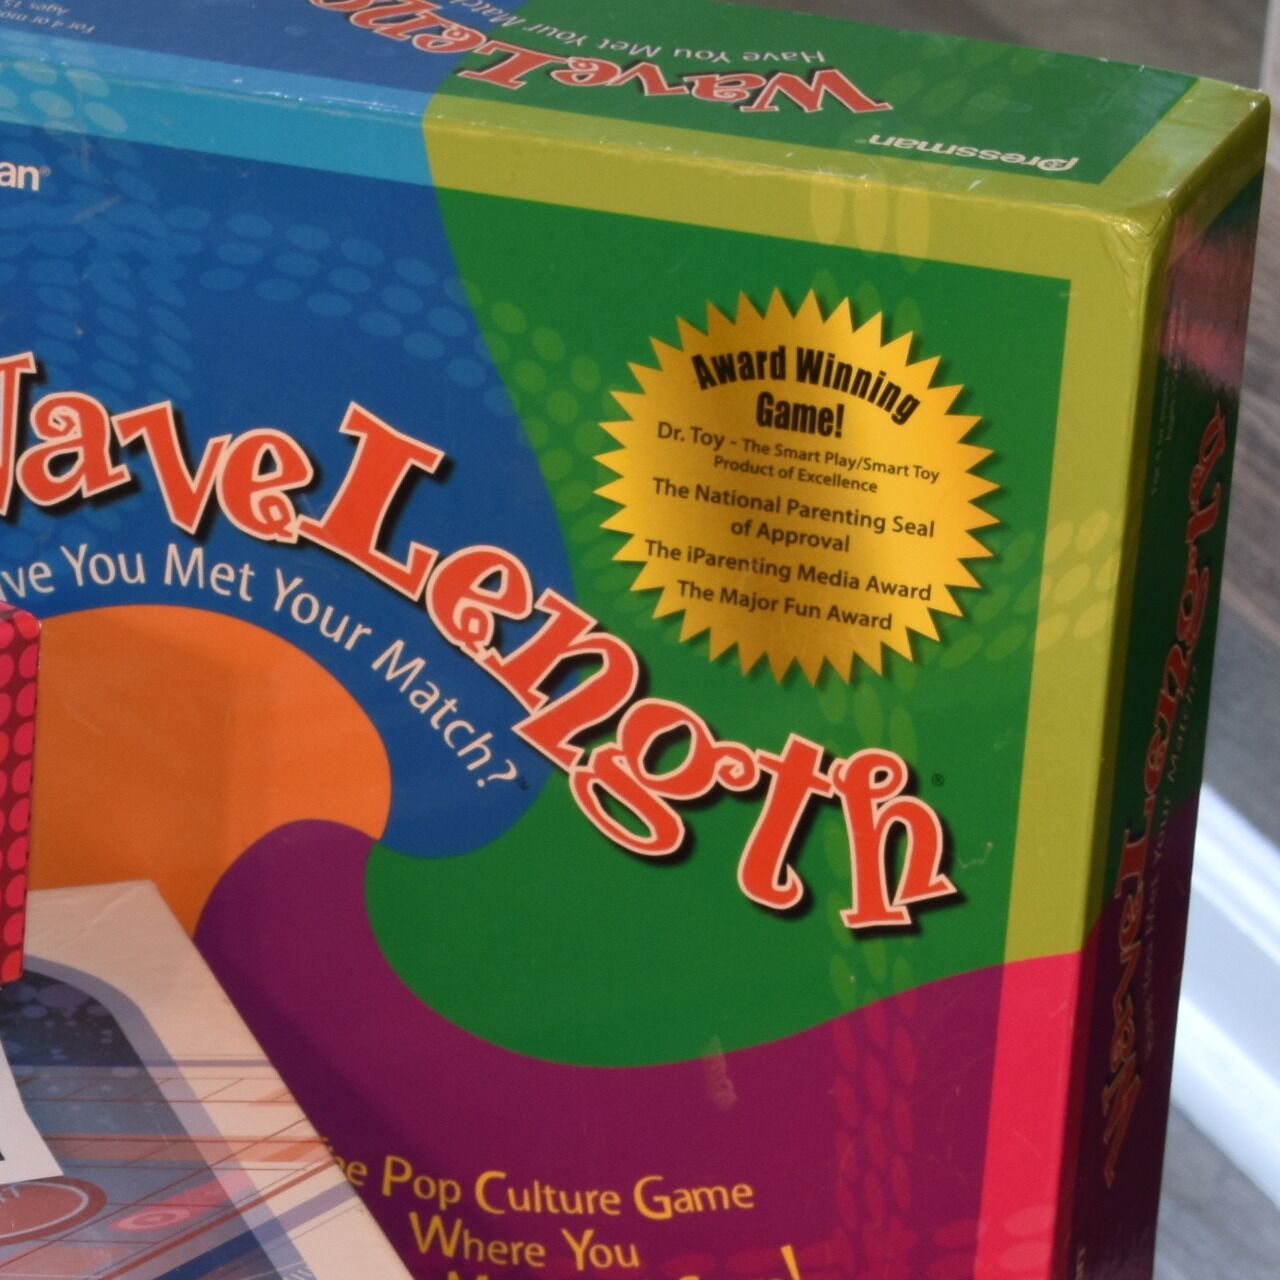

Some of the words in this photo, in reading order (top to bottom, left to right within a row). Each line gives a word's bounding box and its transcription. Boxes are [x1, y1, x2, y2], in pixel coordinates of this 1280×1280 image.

[691, 345, 787, 391] Award
[795, 346, 920, 427] Winning
[756, 391, 844, 438] Game!
[657, 421, 686, 442] Dr.
[690, 426, 726, 451] Toy
[742, 438, 771, 457] The
[773, 443, 822, 465] Smart
[824, 450, 909, 478] Play/Smart
[913, 464, 940, 483] Toy
[714, 455, 775, 477] Product
[778, 464, 794, 480] of
[797, 467, 878, 494] Excellence
[652, 478, 690, 500] The
[695, 484, 781, 513] National
[787, 500, 887, 534] Parenting
[891, 516, 935, 538] Seal
[730, 519, 752, 537] of
[755, 523, 850, 552] Approval
[645, 539, 681, 560] The
[687, 544, 792, 583] iParenting
[797, 565, 860, 590] Media
[865, 575, 932, 602] Award
[677, 580, 713, 602] The
[719, 585, 778, 614] Major
[784, 597, 821, 619] Fun
[827, 606, 893, 631] Award
[60, 543, 145, 587] You
[163, 543, 256, 602] Met
[274, 568, 373, 653] Your
[371, 640, 520, 789] Match?
[382, 1155, 461, 1210] Pop
[474, 1170, 622, 1216] Culture
[633, 1174, 755, 1220] Game
[408, 1211, 546, 1267] Where
[562, 1228, 640, 1271] You
